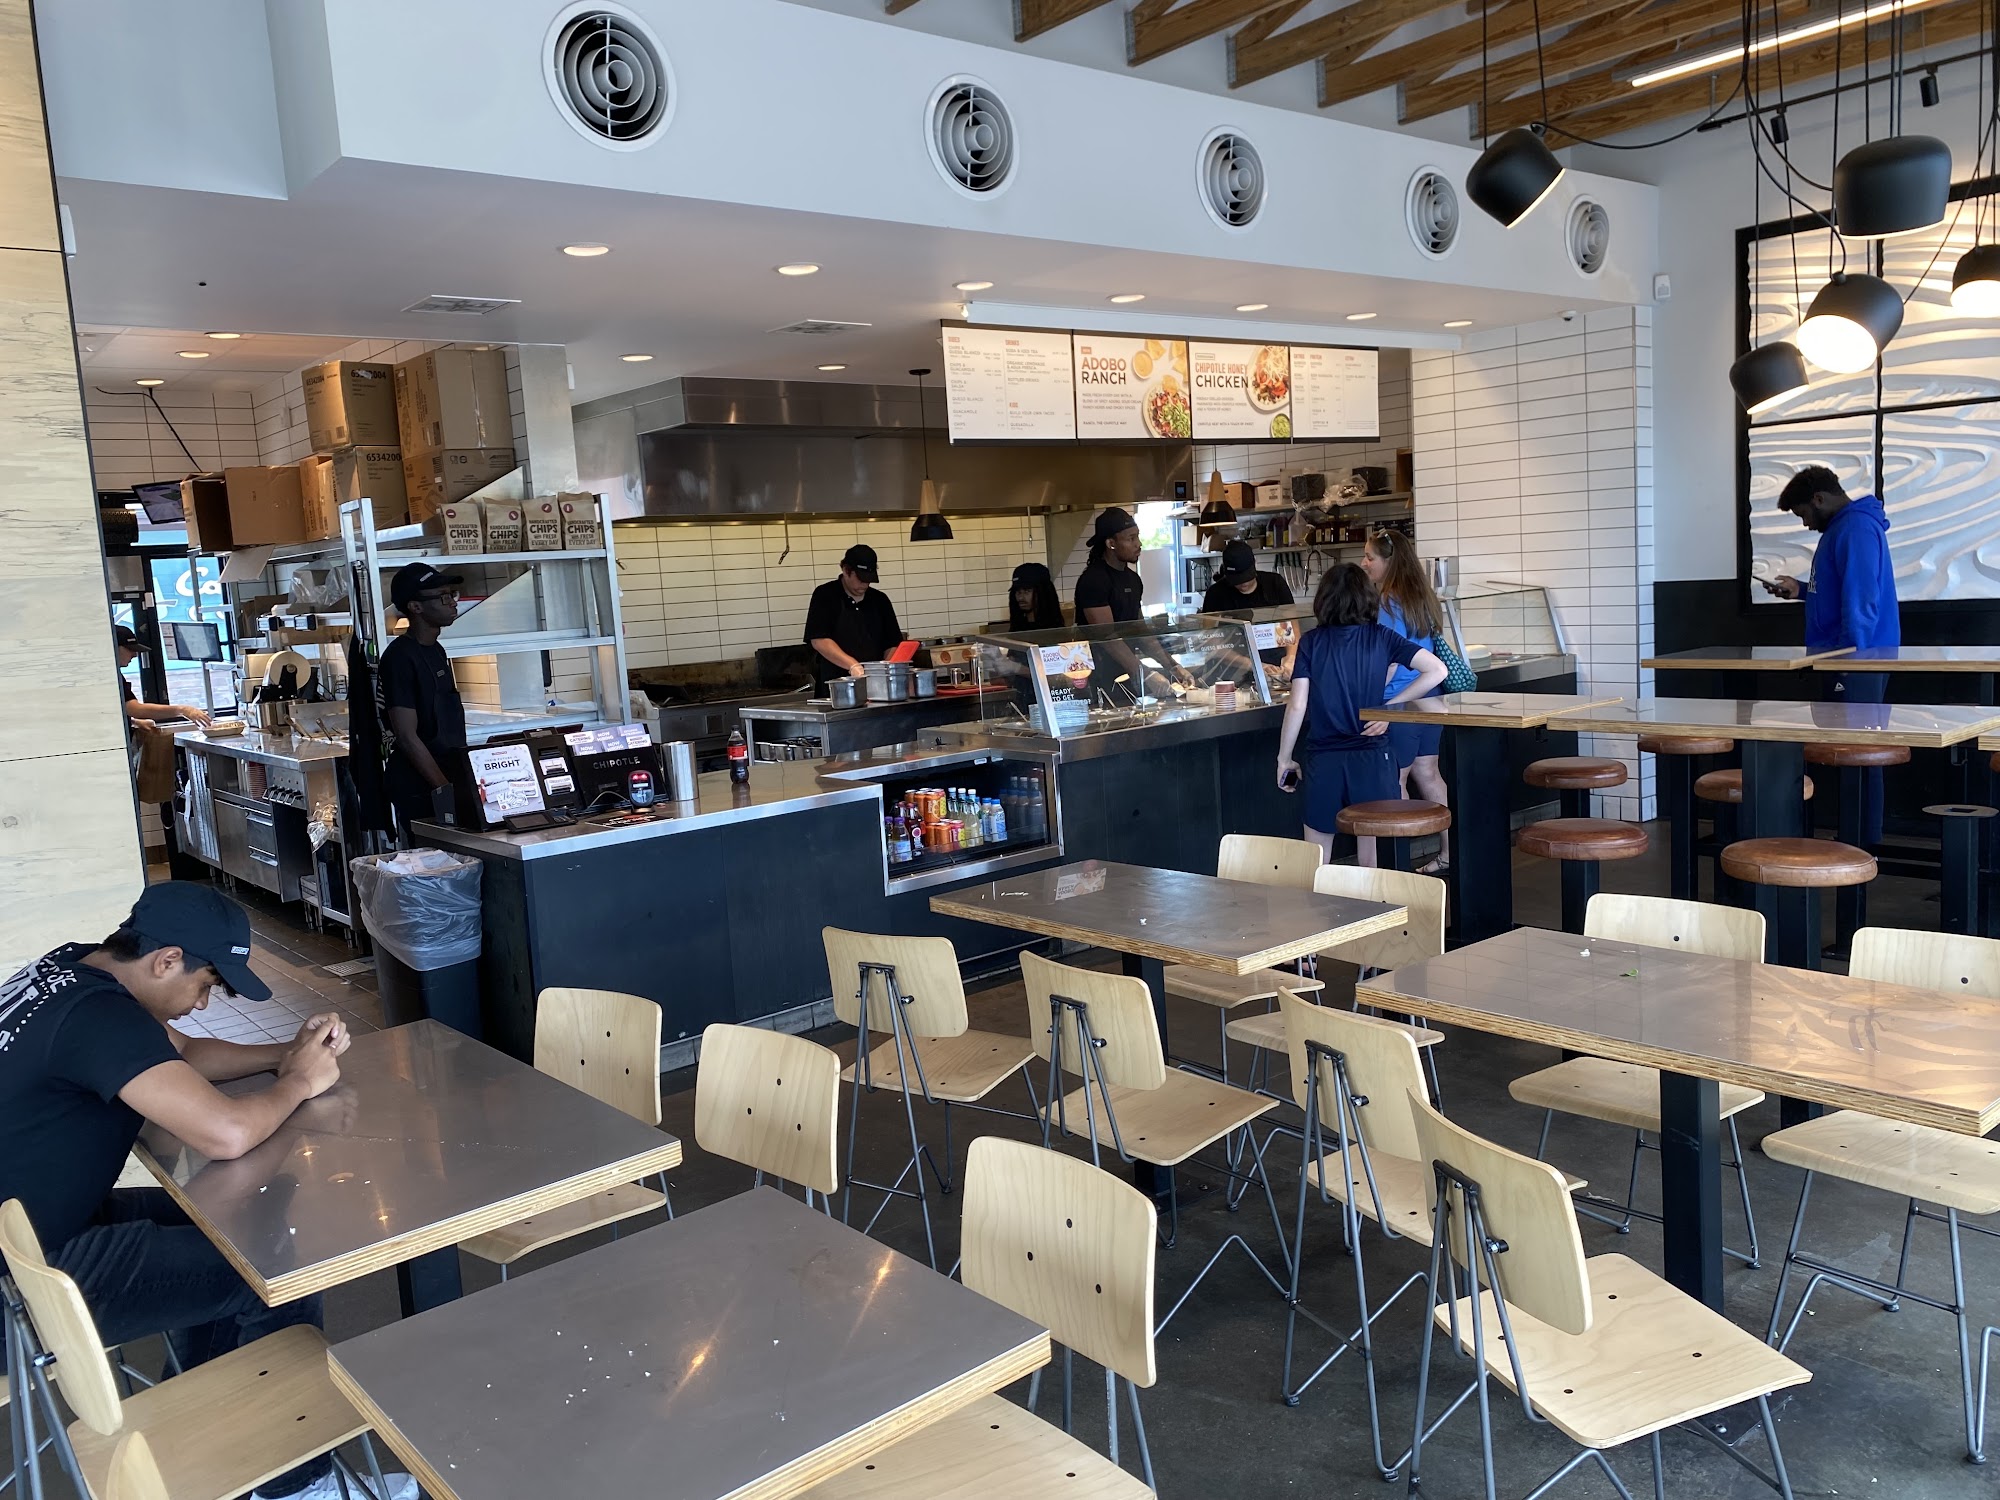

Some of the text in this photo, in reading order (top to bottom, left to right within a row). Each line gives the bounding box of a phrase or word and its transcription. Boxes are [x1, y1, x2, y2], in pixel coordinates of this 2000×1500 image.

[1082, 357, 1126, 371] ADOBO
[1195, 362, 1248, 374] CHIPOTLE HONEY
[351, 369, 387, 379] 65004
[1082, 371, 1126, 384] RANCH
[1196, 375, 1248, 388] CHICKEN
[366, 453, 402, 461] 6534200
[450, 529, 479, 538] CHIPS
[530, 525, 558, 533] CHIPS
[568, 525, 595, 533] CHIPS
[490, 530, 519, 539] CHIPS
[1051, 688, 1071, 696] READY
[484, 759, 521, 770] BRIGHT
[593, 756, 640, 770] CHIPOTLE
